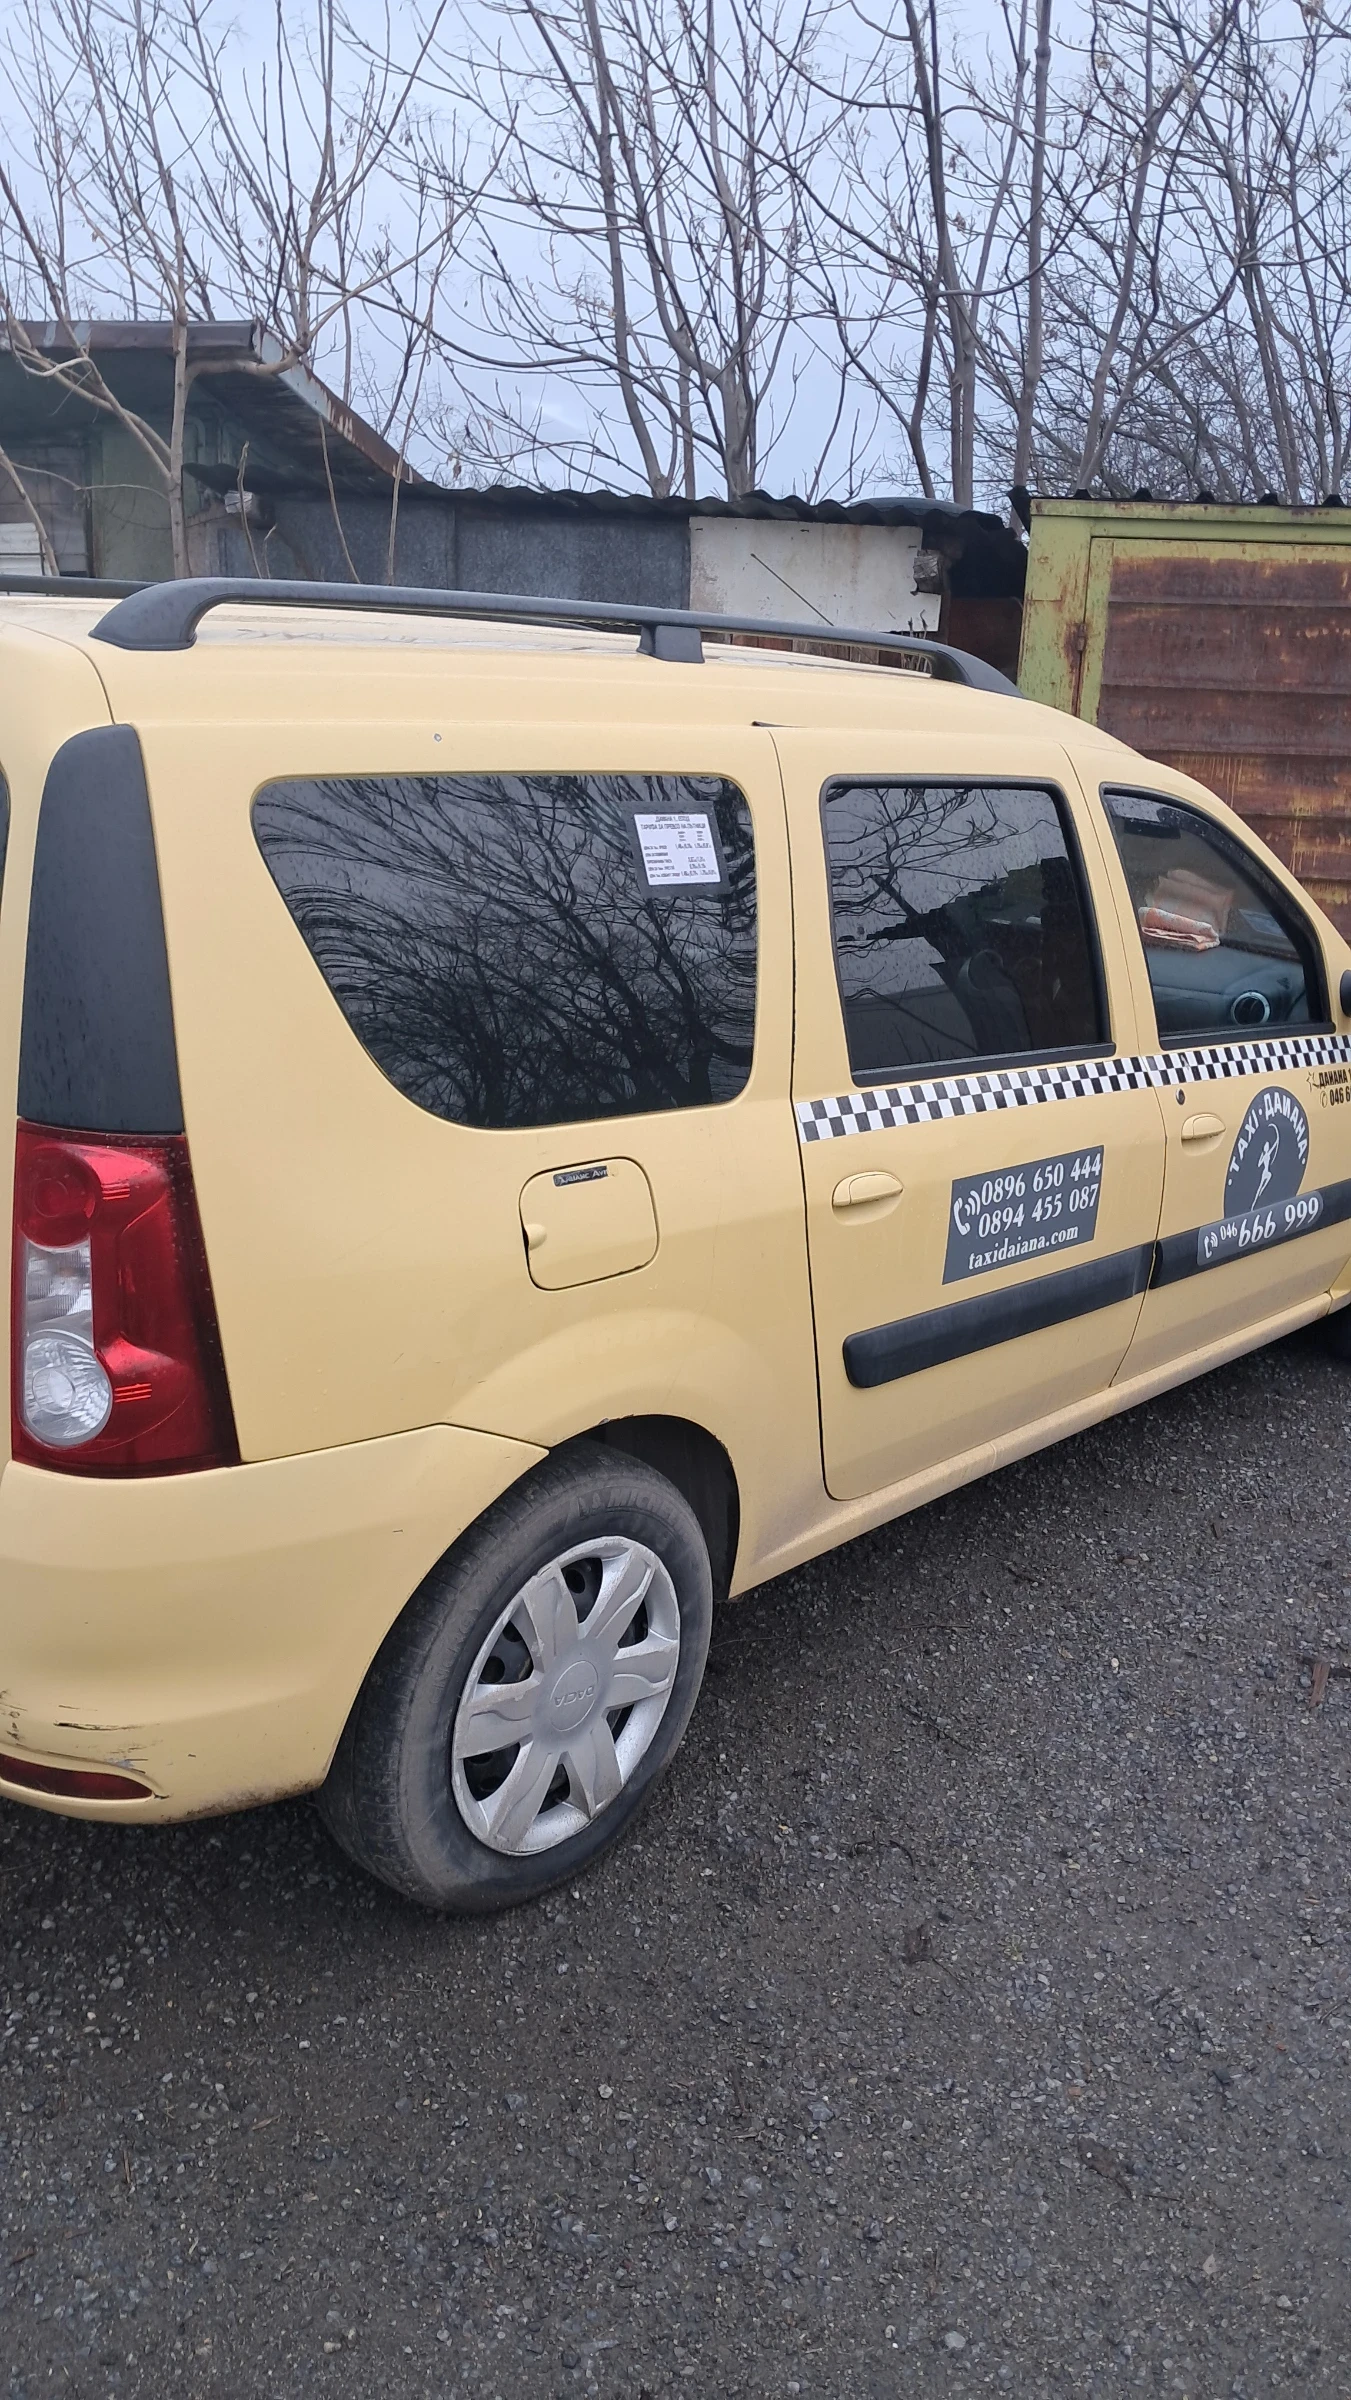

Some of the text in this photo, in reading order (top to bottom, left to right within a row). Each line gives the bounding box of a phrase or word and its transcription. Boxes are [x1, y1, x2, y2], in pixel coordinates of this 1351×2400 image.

[1329, 1087, 1344, 1106] 046
[981, 1153, 1102, 1206] 0896 650 444
[978, 1183, 1099, 1238] 0894 455 087
[1219, 1197, 1320, 1248] 046 666 999
[968, 1225, 1079, 1270] taxidaiana.com
[554, 1685, 594, 1708] DACIA
